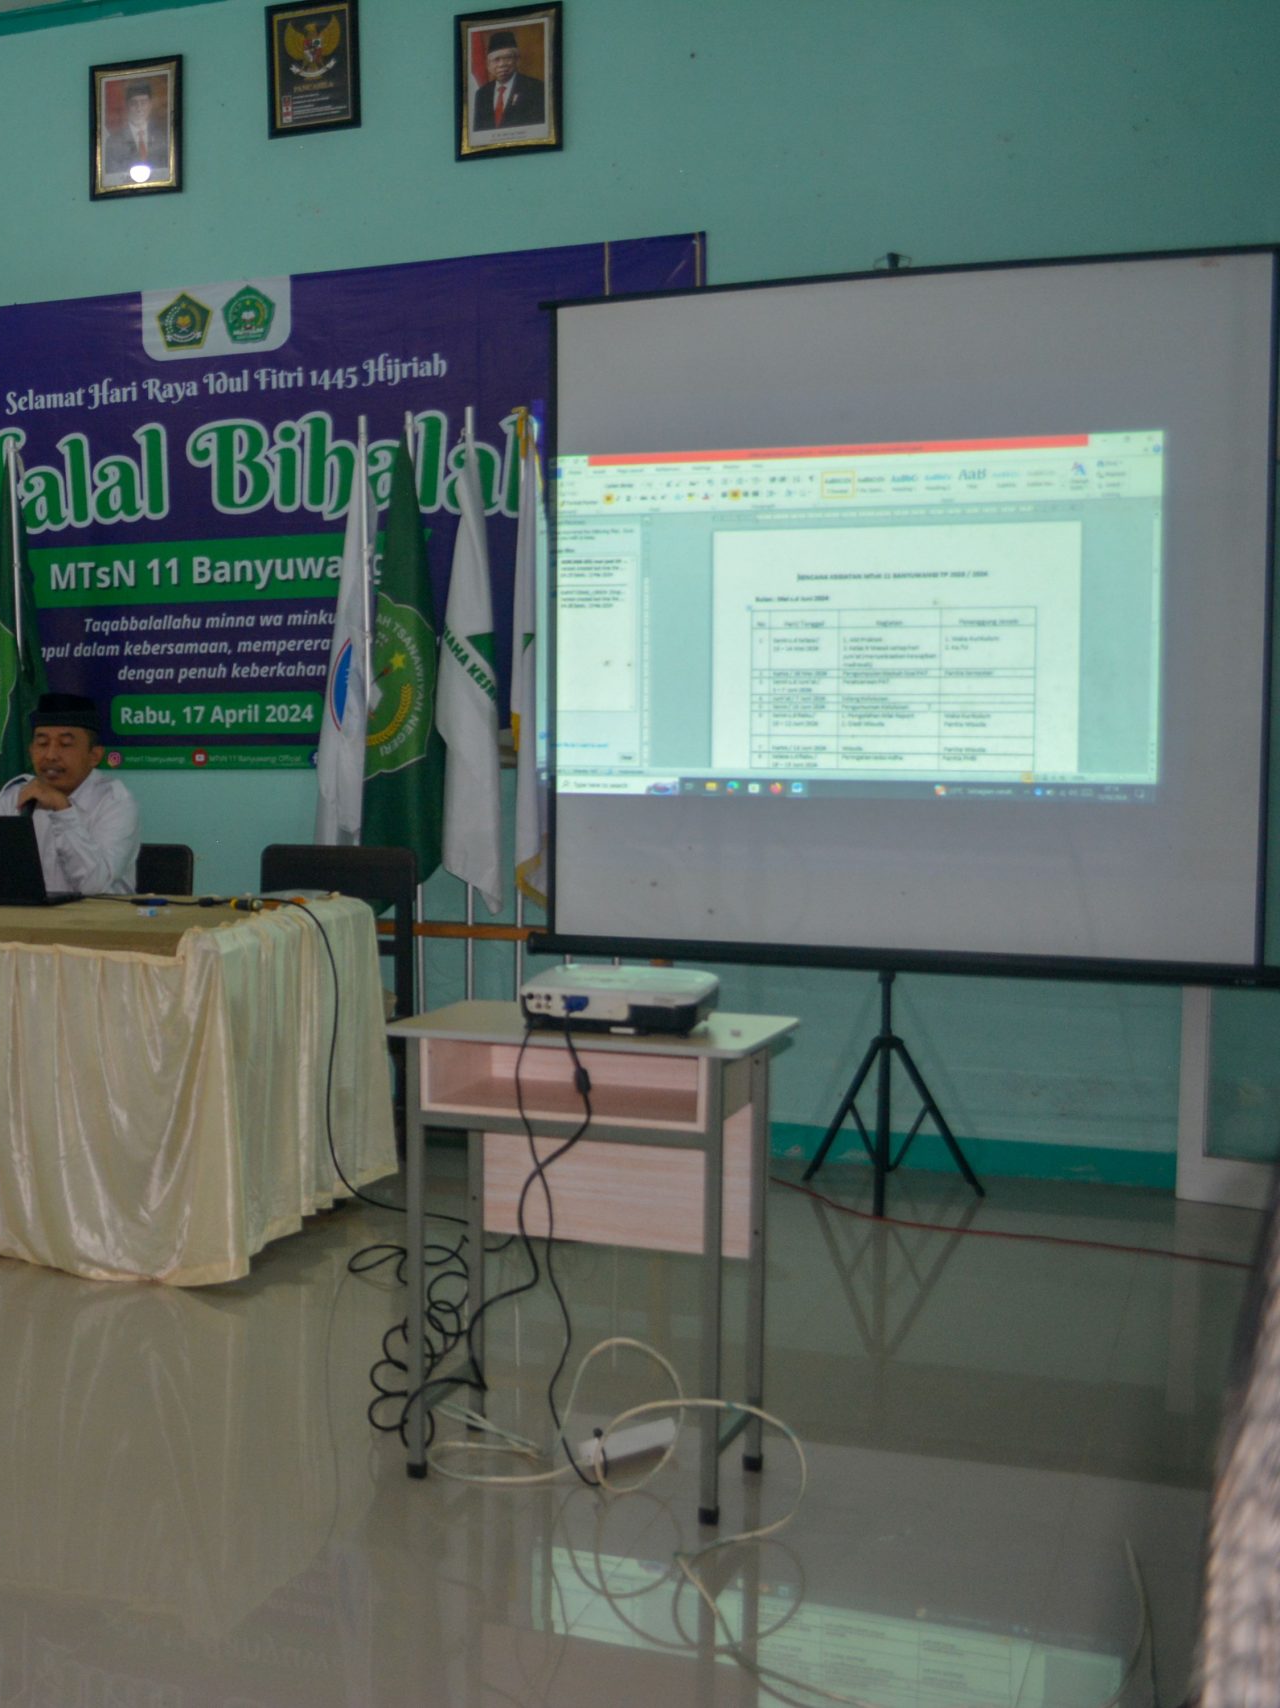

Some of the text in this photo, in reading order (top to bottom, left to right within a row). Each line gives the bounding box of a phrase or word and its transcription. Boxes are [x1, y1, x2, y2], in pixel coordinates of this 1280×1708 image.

[5, 353, 447, 415] Selamat Hari Raya Idul Fitri 1445 Hijriah
[50, 552, 383, 591] MTsN 11 Banyuwa
[84, 610, 336, 636] Taqabbalallahu minna wa minku
[73, 640, 120, 658] dalam
[123, 640, 232, 657] kebersamaan,
[117, 664, 174, 685] dengan
[178, 662, 227, 684] penuh
[231, 660, 327, 679] keberkahan
[120, 703, 314, 728] Rabu, 17 April 2024
[379, 716, 420, 757] NEGERI
